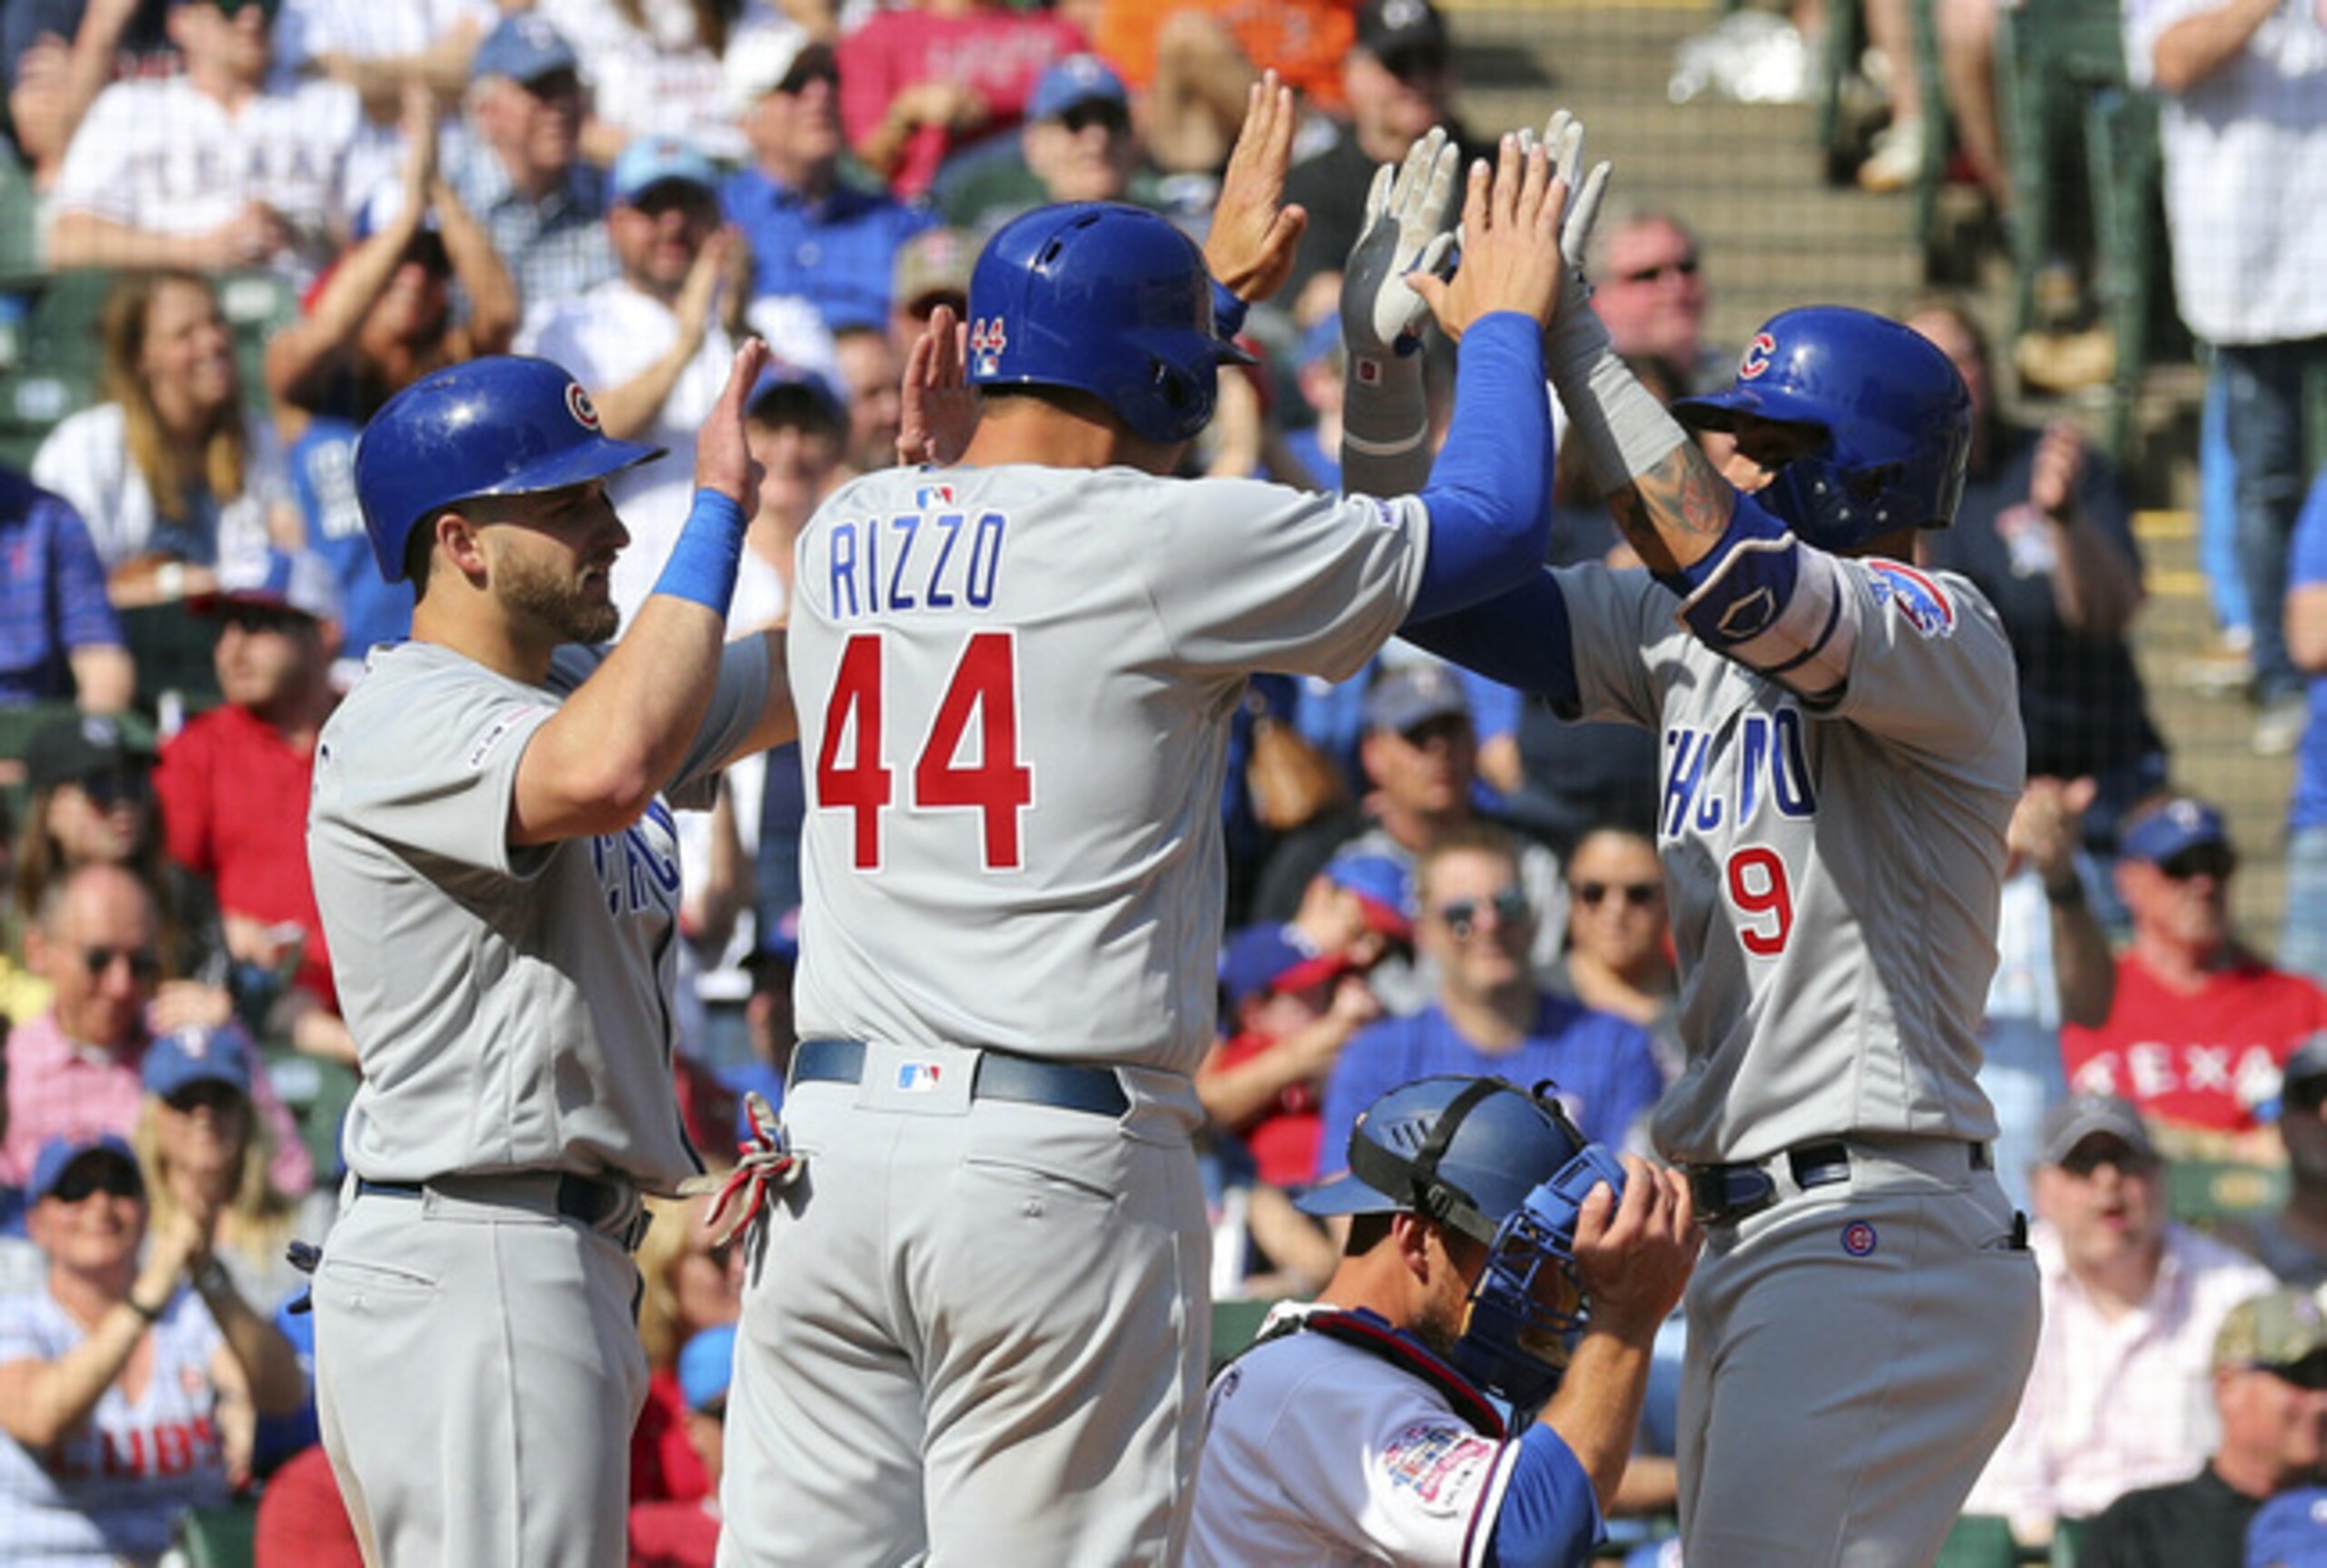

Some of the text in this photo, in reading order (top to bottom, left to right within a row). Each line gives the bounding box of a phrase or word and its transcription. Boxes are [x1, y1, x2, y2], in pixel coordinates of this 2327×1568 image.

[970, 316, 1006, 355] 44
[1739, 333, 1775, 380] C
[827, 511, 1009, 621] RIZZO
[814, 630, 1034, 872] 44
[1726, 845, 1794, 956] 9
